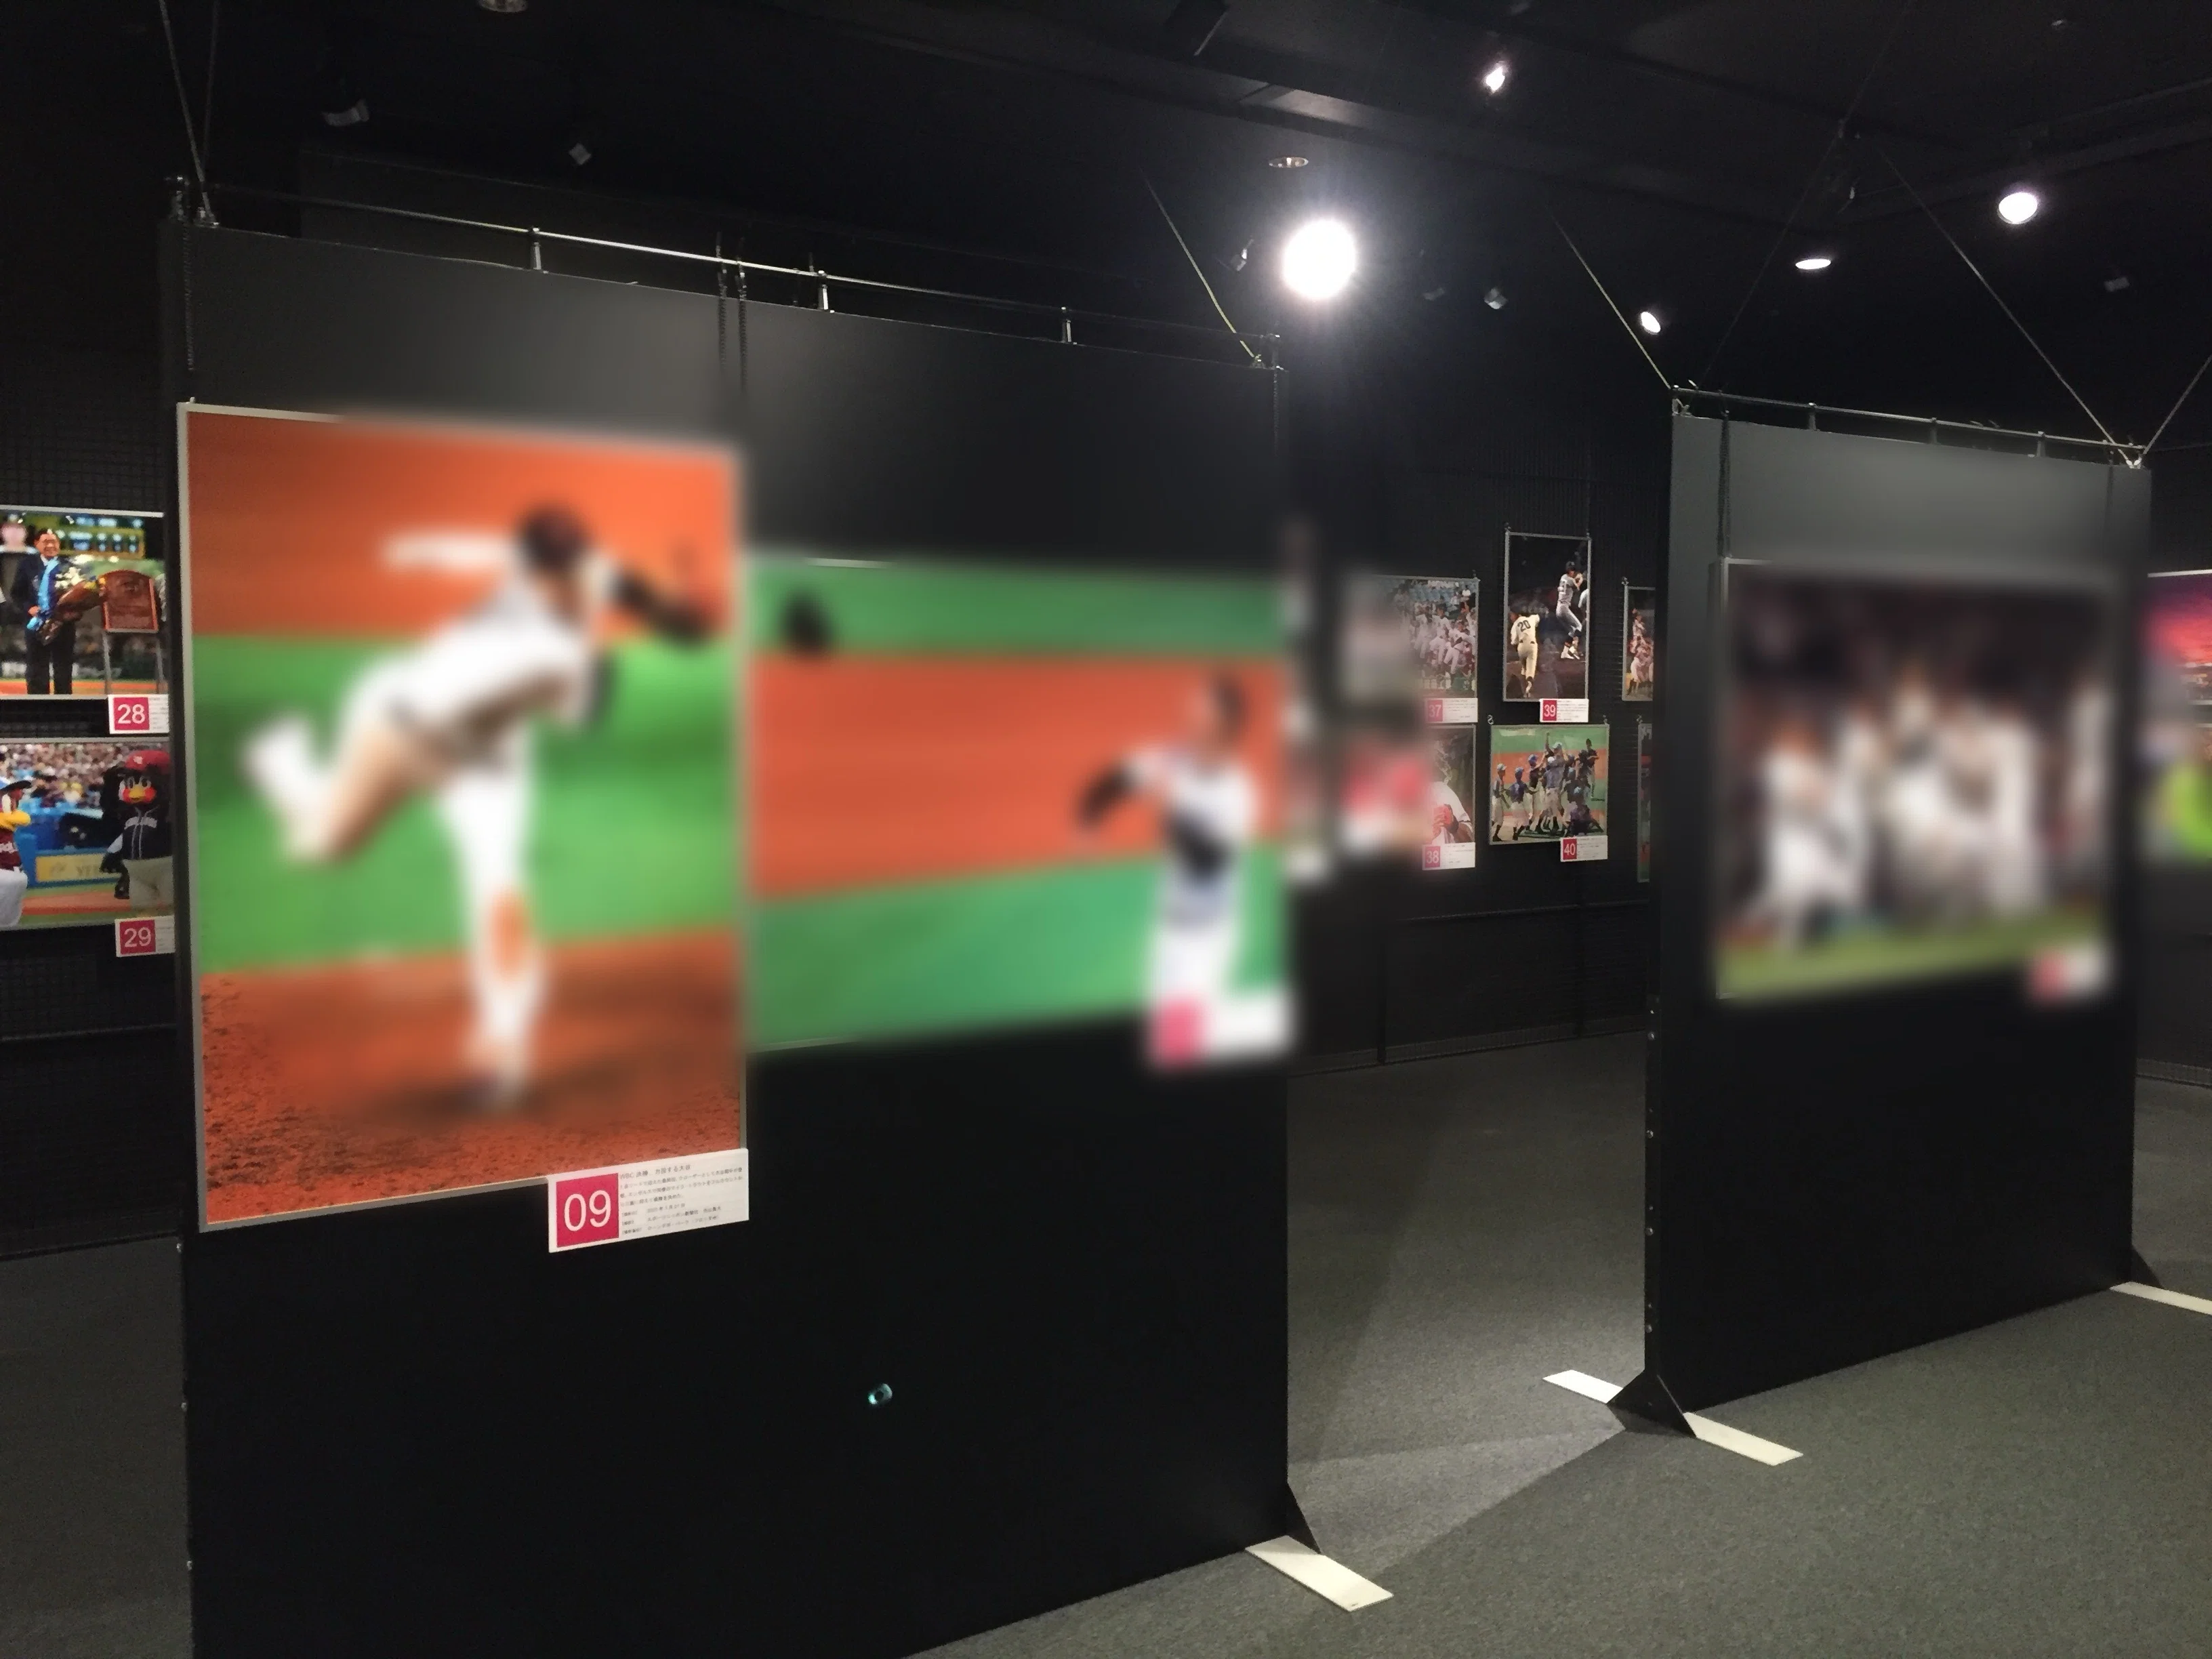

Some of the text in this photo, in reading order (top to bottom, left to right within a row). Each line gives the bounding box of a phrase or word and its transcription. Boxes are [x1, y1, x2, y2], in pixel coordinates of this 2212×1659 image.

[1517, 619, 1532, 632] 20
[117, 703, 146, 724] 28
[1428, 704, 1442, 717] 37
[1544, 704, 1556, 717] 39
[1426, 850, 1439, 864] 38
[1563, 844, 1576, 857] 40
[124, 926, 152, 947] 29
[564, 1189, 612, 1231] 09
